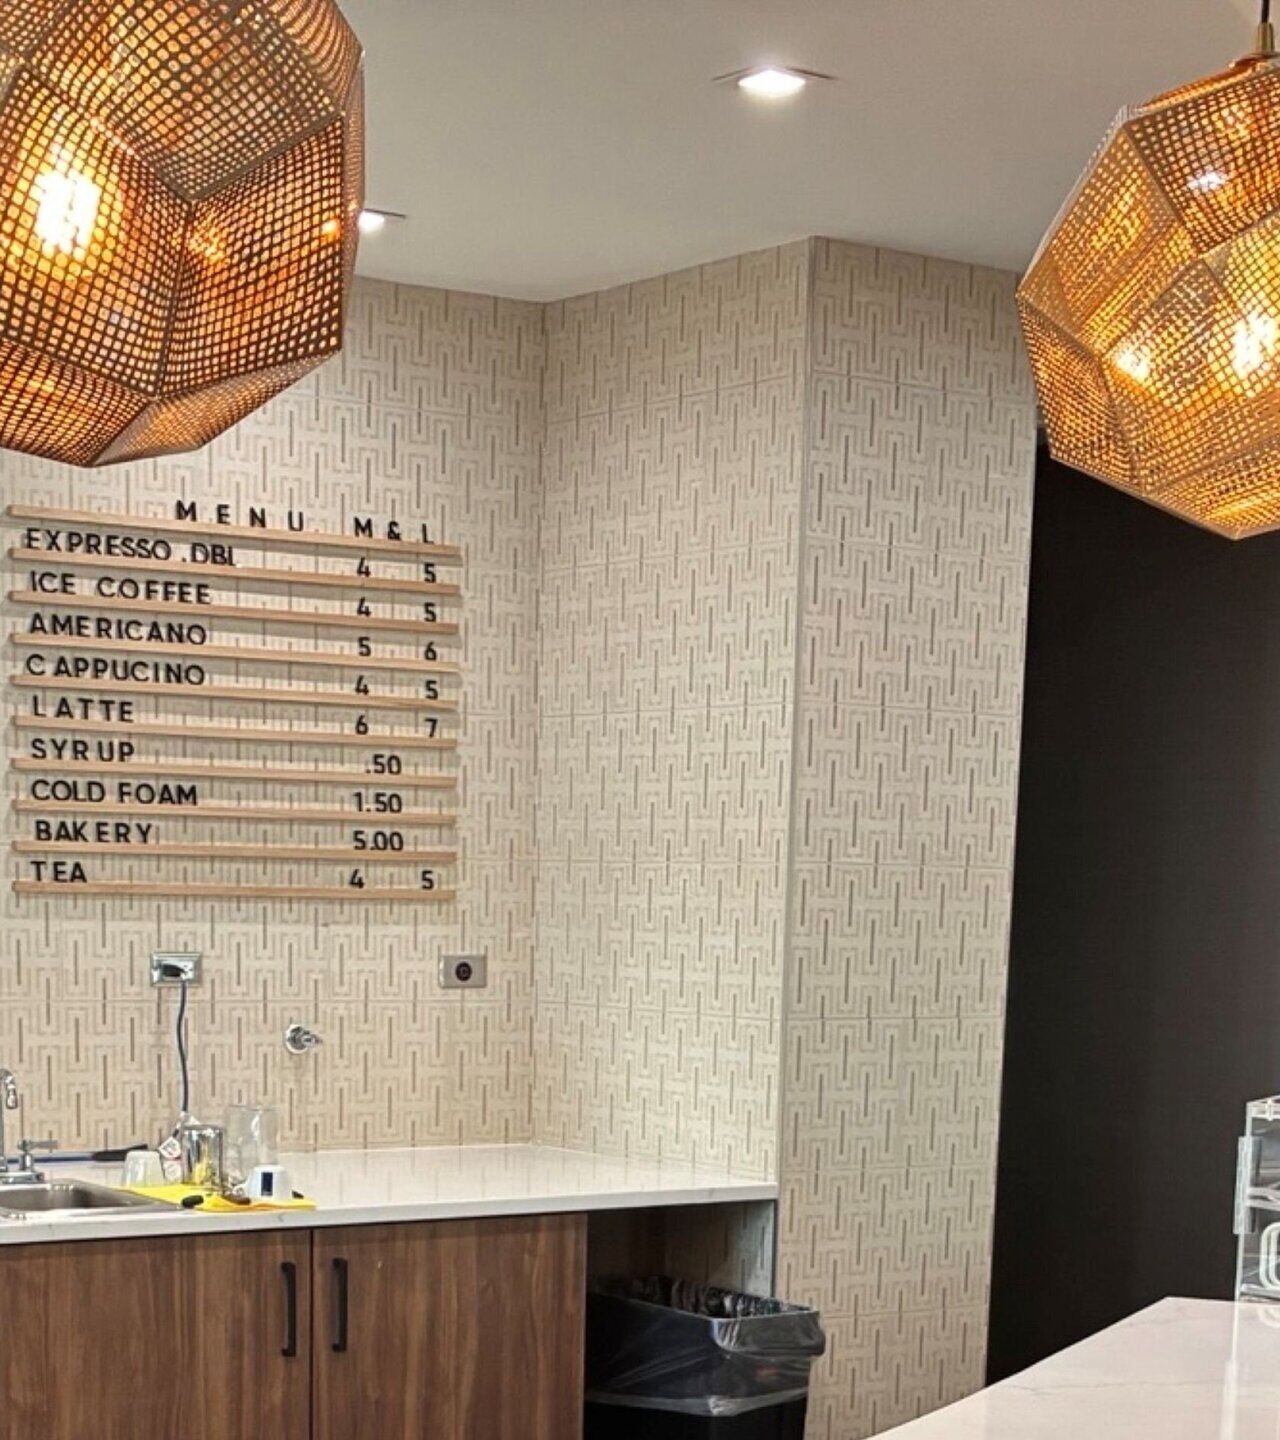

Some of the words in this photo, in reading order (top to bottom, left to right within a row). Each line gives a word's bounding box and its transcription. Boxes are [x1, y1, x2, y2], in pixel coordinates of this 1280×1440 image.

[176, 501, 304, 531] MENU
[354, 517, 374, 539] M
[387, 521, 401, 541] &
[422, 524, 434, 544] L
[26, 528, 171, 560] EXPRESSO
[357, 558, 371, 577] 4
[424, 563, 436, 583] 5
[31, 571, 75, 594] ICE
[97, 577, 210, 604] COFFEE
[357, 597, 371, 617] 4
[424, 603, 436, 622] 5
[29, 613, 206, 645] AMERICANO
[358, 637, 371, 657] 5
[425, 642, 437, 661] 6
[26, 655, 205, 685] CAPPUCINO
[355, 676, 369, 695] 4
[425, 681, 438, 700] 5
[34, 696, 133, 723] LATTE
[355, 716, 368, 735] 6
[425, 718, 438, 738] 7
[31, 739, 135, 763] SYRUP
[365, 754, 401, 775] .50
[31, 780, 105, 803] COLD
[119, 783, 198, 806] FOAM
[354, 792, 402, 813] 1.50
[35, 821, 153, 843] BAKERY
[353, 831, 403, 852] 5.00
[32, 862, 87, 883] TEA
[350, 869, 364, 889] 4
[421, 871, 433, 890] 5
